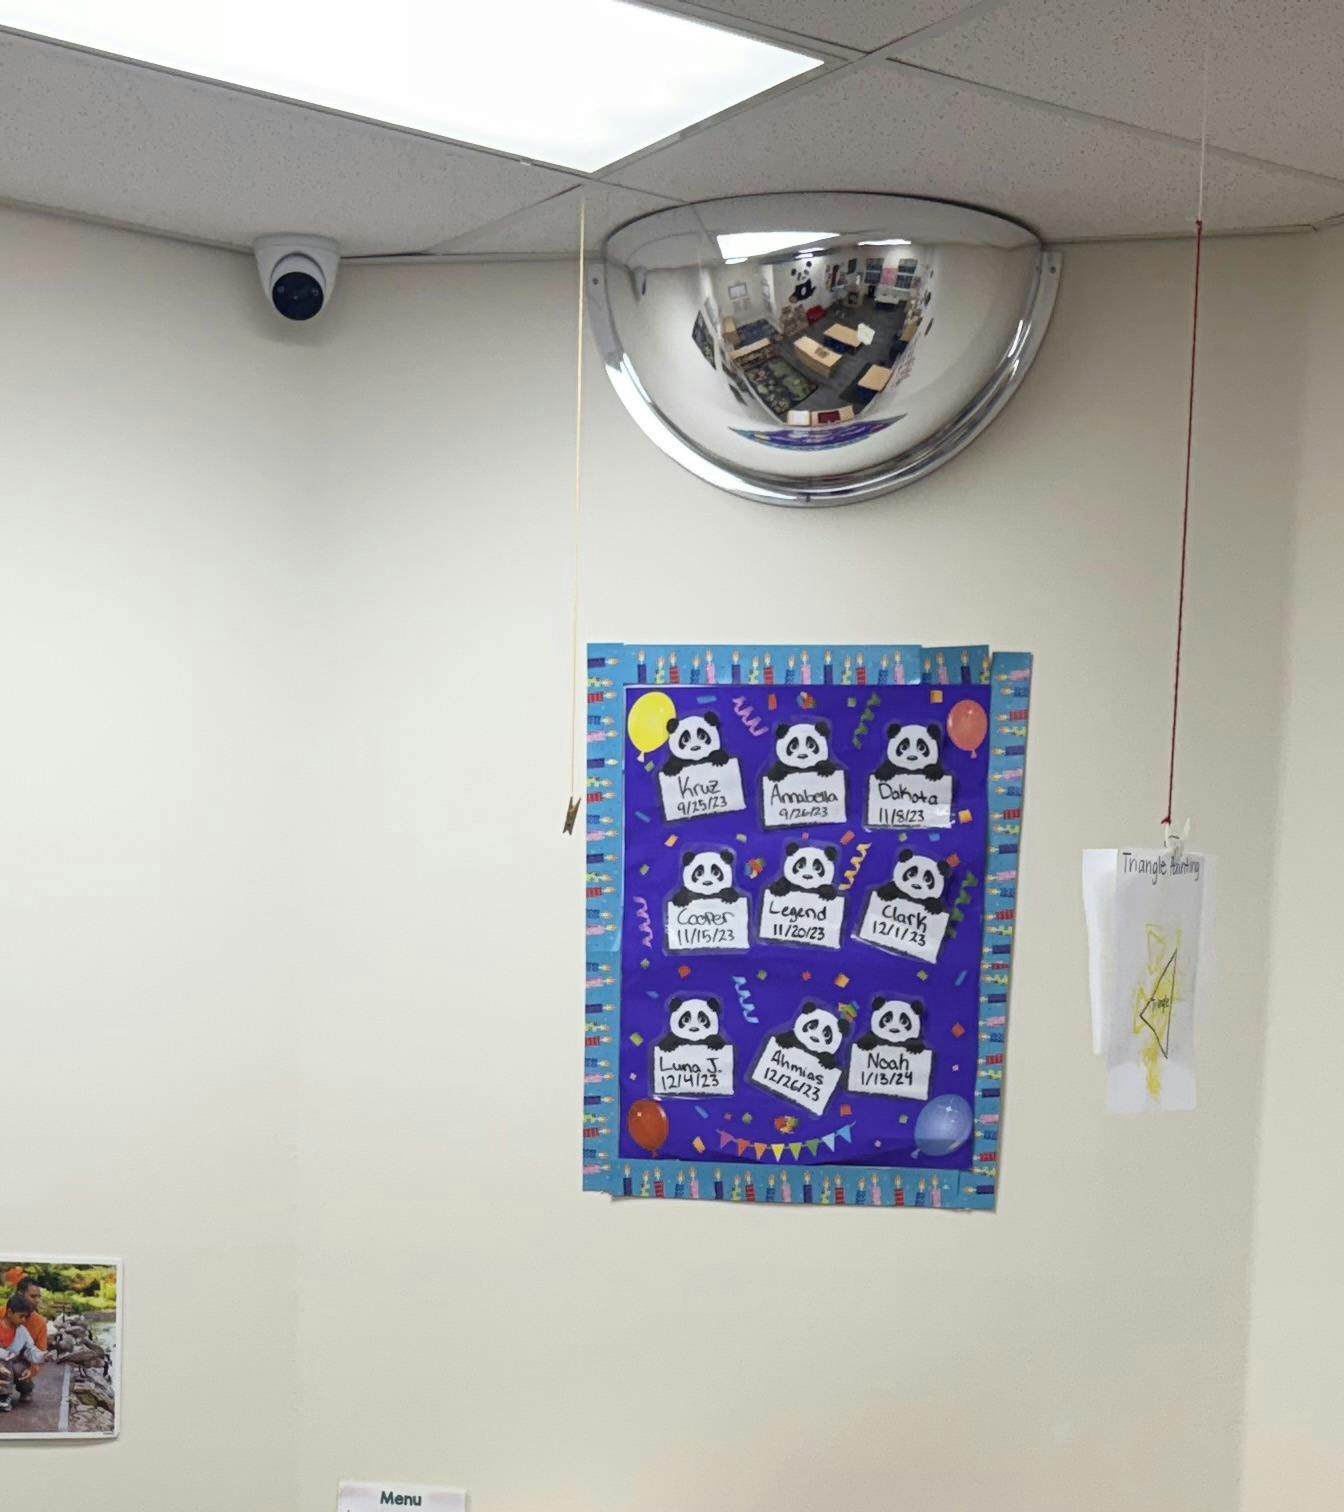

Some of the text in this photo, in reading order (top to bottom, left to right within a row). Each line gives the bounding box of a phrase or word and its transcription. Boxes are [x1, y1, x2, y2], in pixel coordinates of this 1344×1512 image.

[678, 776, 720, 799] Kruz
[770, 783, 839, 805] Annabella
[677, 796, 728, 816] 9/25/23
[779, 806, 829, 820] 9/26/23
[879, 807, 925, 825] 11/8/23
[769, 901, 828, 922] Legend
[882, 905, 929, 934] Clark
[677, 929, 735, 945] 11/15/23
[773, 924, 826, 940] 11/20/23
[872, 920, 926, 947] 12/1/23
[659, 1056, 701, 1073] Luna
[770, 1050, 824, 1085] Ahmias
[867, 1052, 910, 1071] Noah
[662, 1074, 720, 1091] 12/4/23
[763, 1067, 821, 1102] 12/26/23
[861, 1071, 913, 1086] 1/13/24
[380, 1491, 422, 1506] Menu
